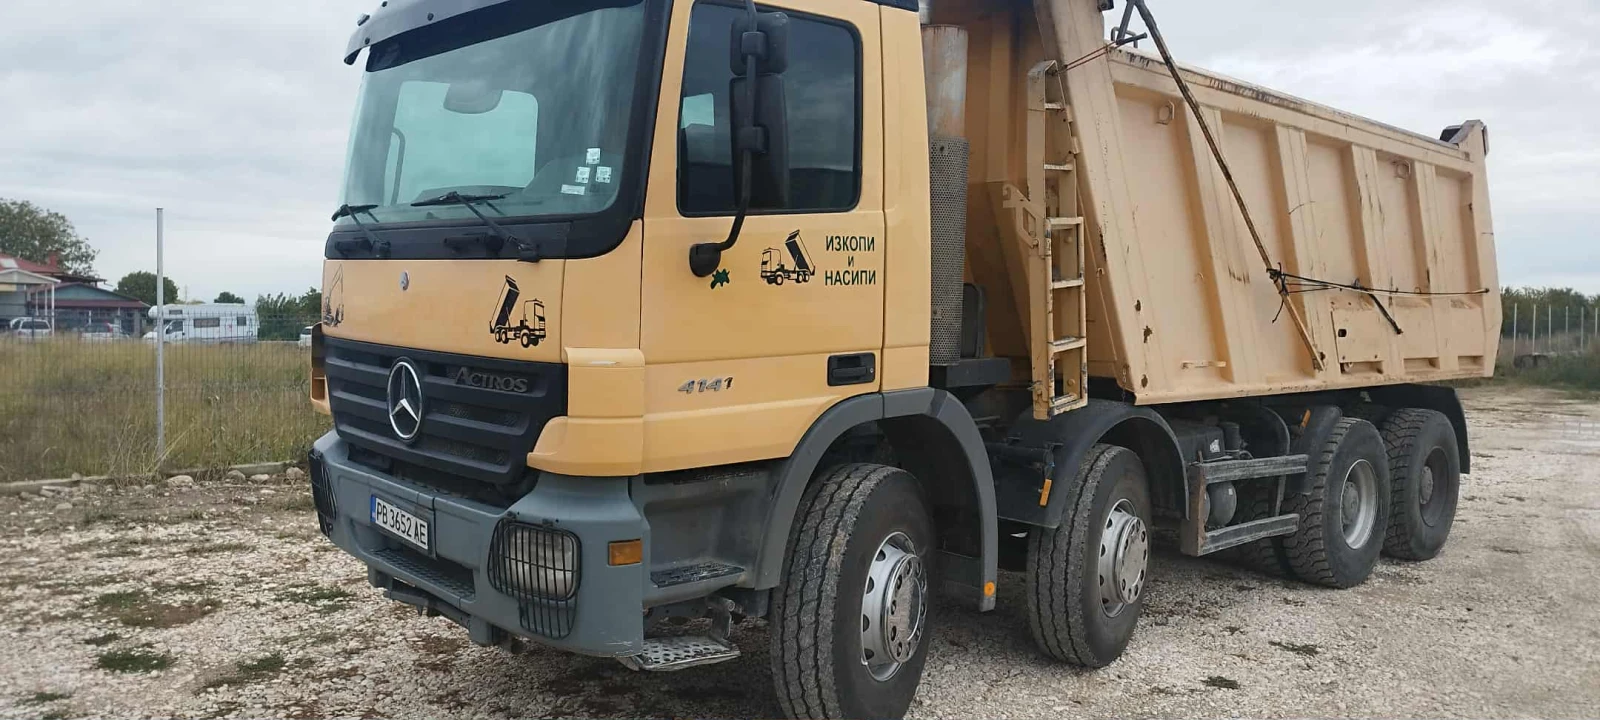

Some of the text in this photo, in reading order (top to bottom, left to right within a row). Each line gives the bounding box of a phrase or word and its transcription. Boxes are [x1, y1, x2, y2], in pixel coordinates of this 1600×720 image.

[825, 235, 875, 251] ИЗКОПИ
[825, 270, 876, 285] НАСИПИ
[677, 376, 733, 394] 4141
[376, 502, 426, 545] PB 3652 AE
